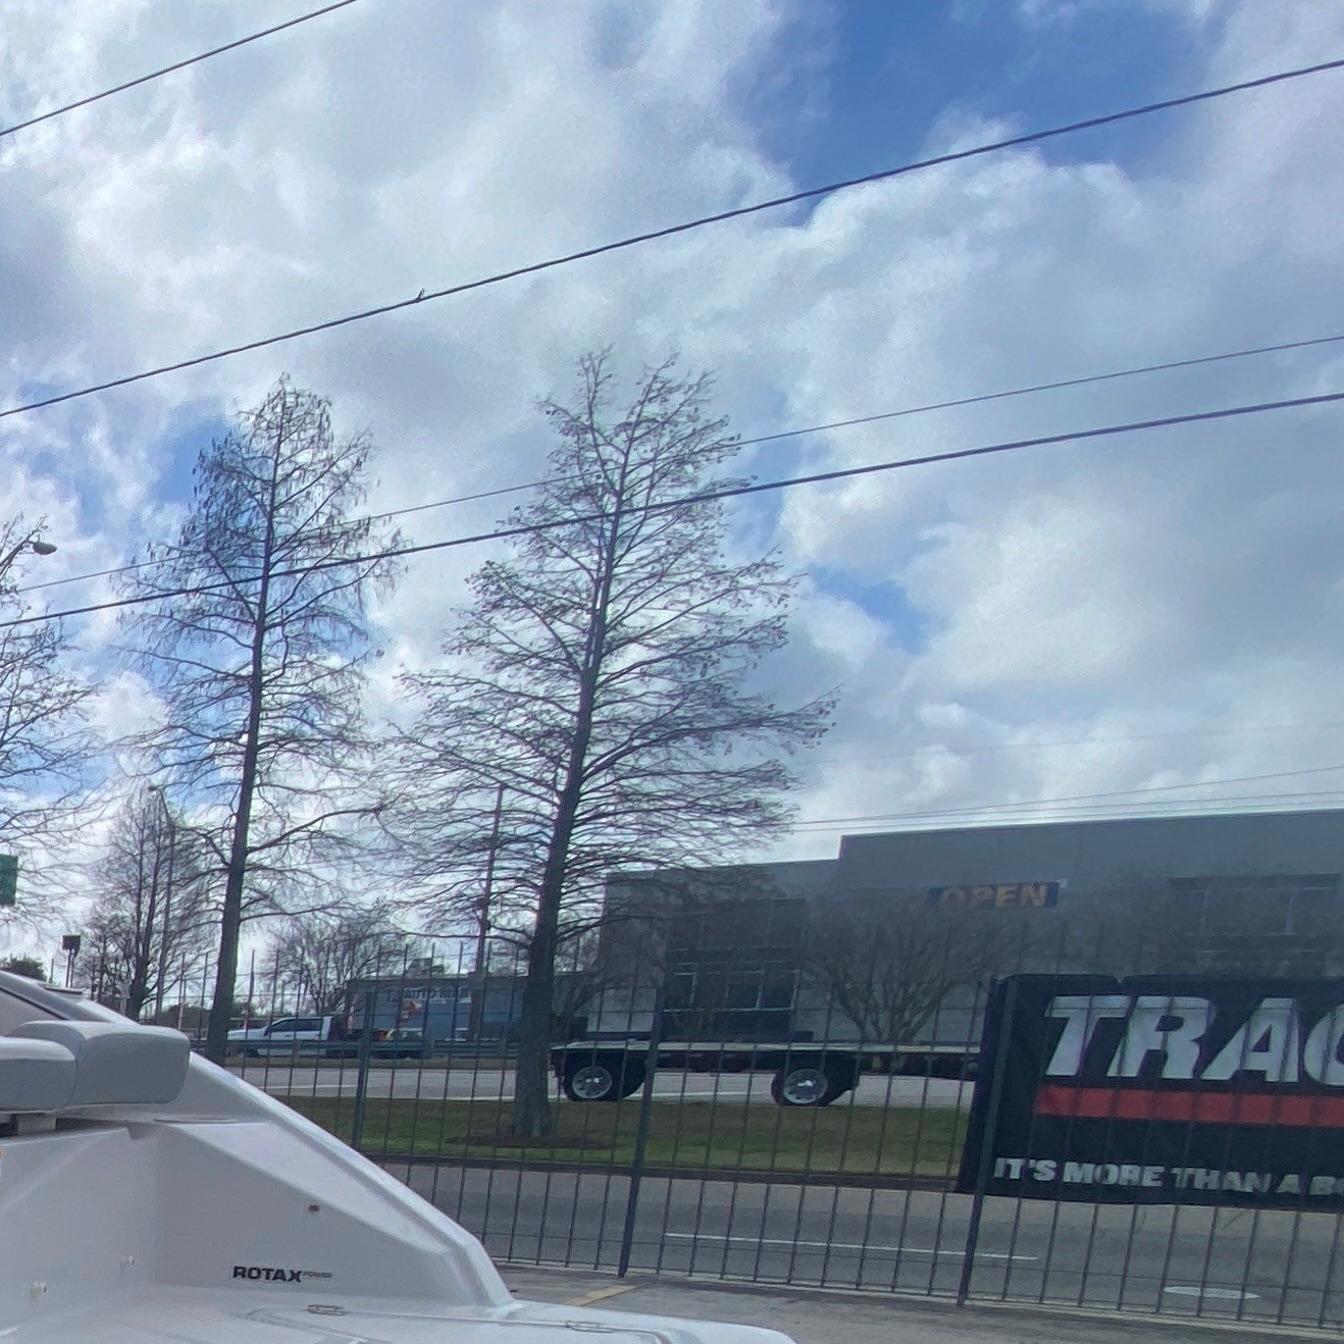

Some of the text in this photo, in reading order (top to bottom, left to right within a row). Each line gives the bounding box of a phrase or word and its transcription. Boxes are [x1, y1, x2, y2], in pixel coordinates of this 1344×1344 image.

[942, 883, 1049, 909] OPEN
[995, 1157, 1058, 1182] IT'S
[1063, 1162, 1165, 1188] MORE
[1171, 1167, 1271, 1193] THAN
[1277, 1174, 1302, 1195] A
[233, 1265, 303, 1283] ROTAX
